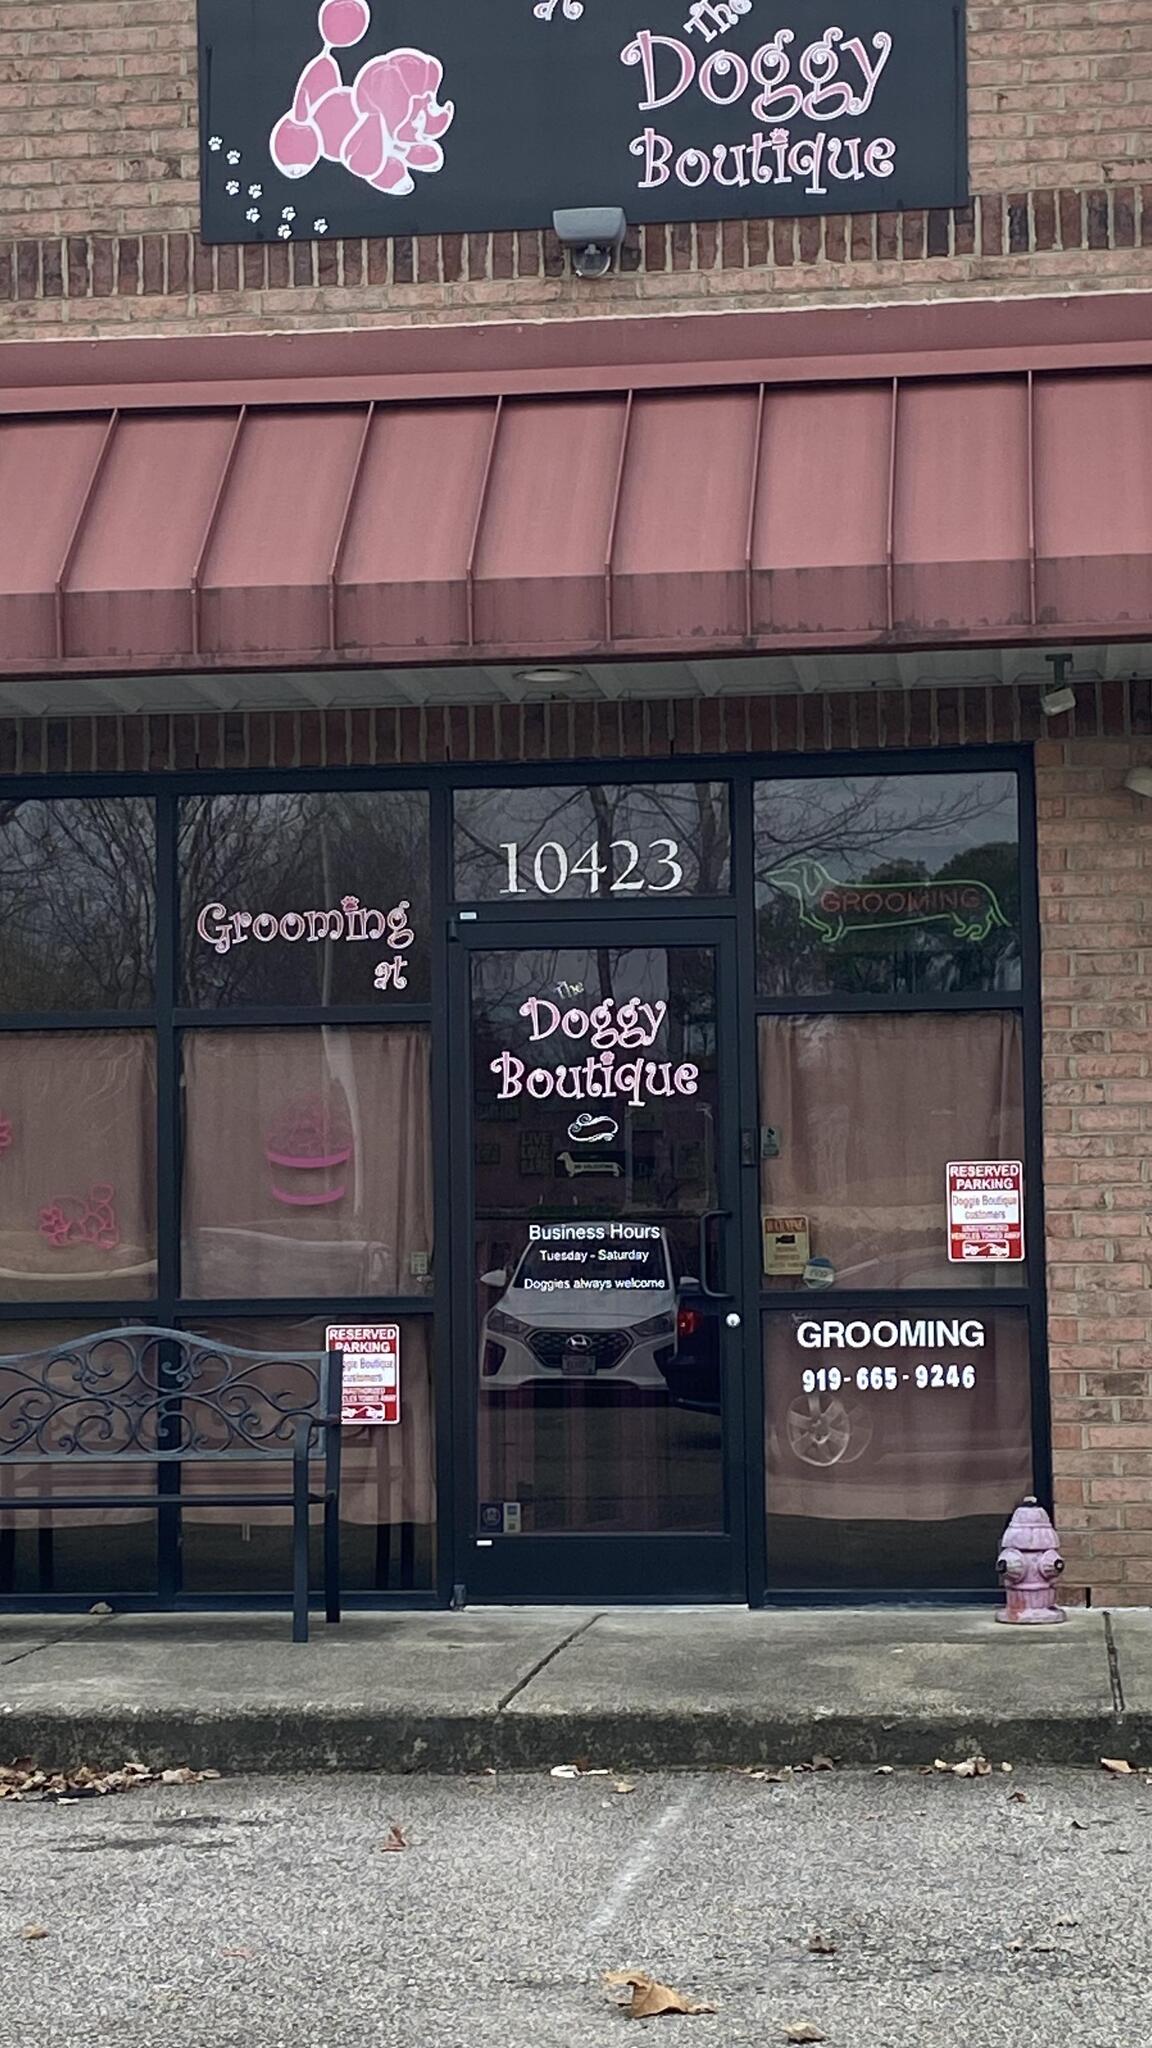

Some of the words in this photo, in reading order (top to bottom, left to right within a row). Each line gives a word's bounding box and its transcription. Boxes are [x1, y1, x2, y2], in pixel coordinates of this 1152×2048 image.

[620, 26, 893, 123] Doggy
[628, 127, 896, 195] Boutique
[499, 838, 684, 895] 10423
[820, 887, 983, 914] GROOMING
[197, 895, 416, 954] Grooming
[373, 955, 409, 990] at
[554, 980, 585, 1000] The
[518, 996, 668, 1050] Doggy
[489, 1050, 700, 1108] Boutique
[949, 1164, 1019, 1178] RESERVED
[956, 1177, 1014, 1190] PARKING
[528, 1223, 605, 1240] Business
[609, 1223, 661, 1240] Hours
[539, 1250, 588, 1264] Tuesday
[597, 1249, 650, 1263] Saturday
[523, 1277, 570, 1291] Doggies
[573, 1276, 612, 1291] always
[615, 1276, 666, 1289] welcome
[328, 1327, 396, 1340] RESERVED
[334, 1341, 391, 1353] PARKING
[796, 1319, 985, 1349] GROOMING
